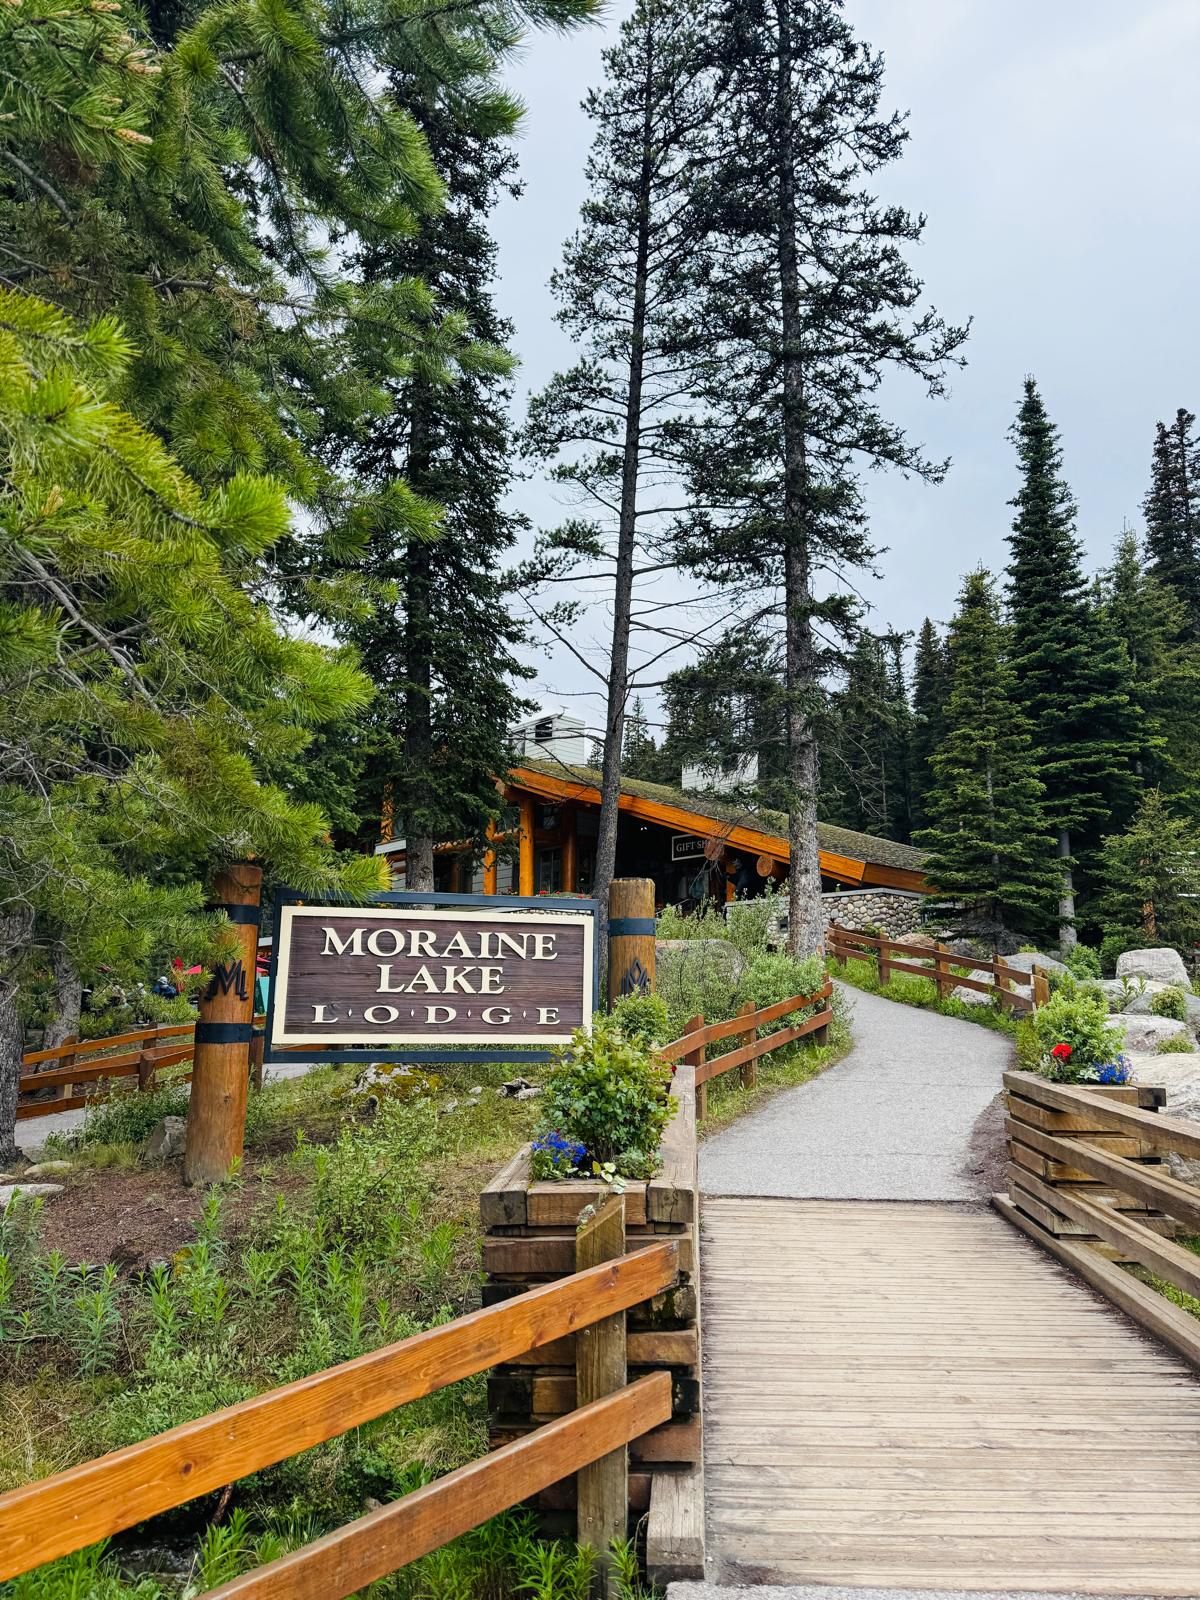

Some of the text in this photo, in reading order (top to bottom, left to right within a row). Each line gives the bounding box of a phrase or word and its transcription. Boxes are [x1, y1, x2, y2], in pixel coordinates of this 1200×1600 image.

[676, 841, 695, 852] GIFT
[320, 928, 558, 960] MORAINE
[376, 964, 505, 994] LAKE
